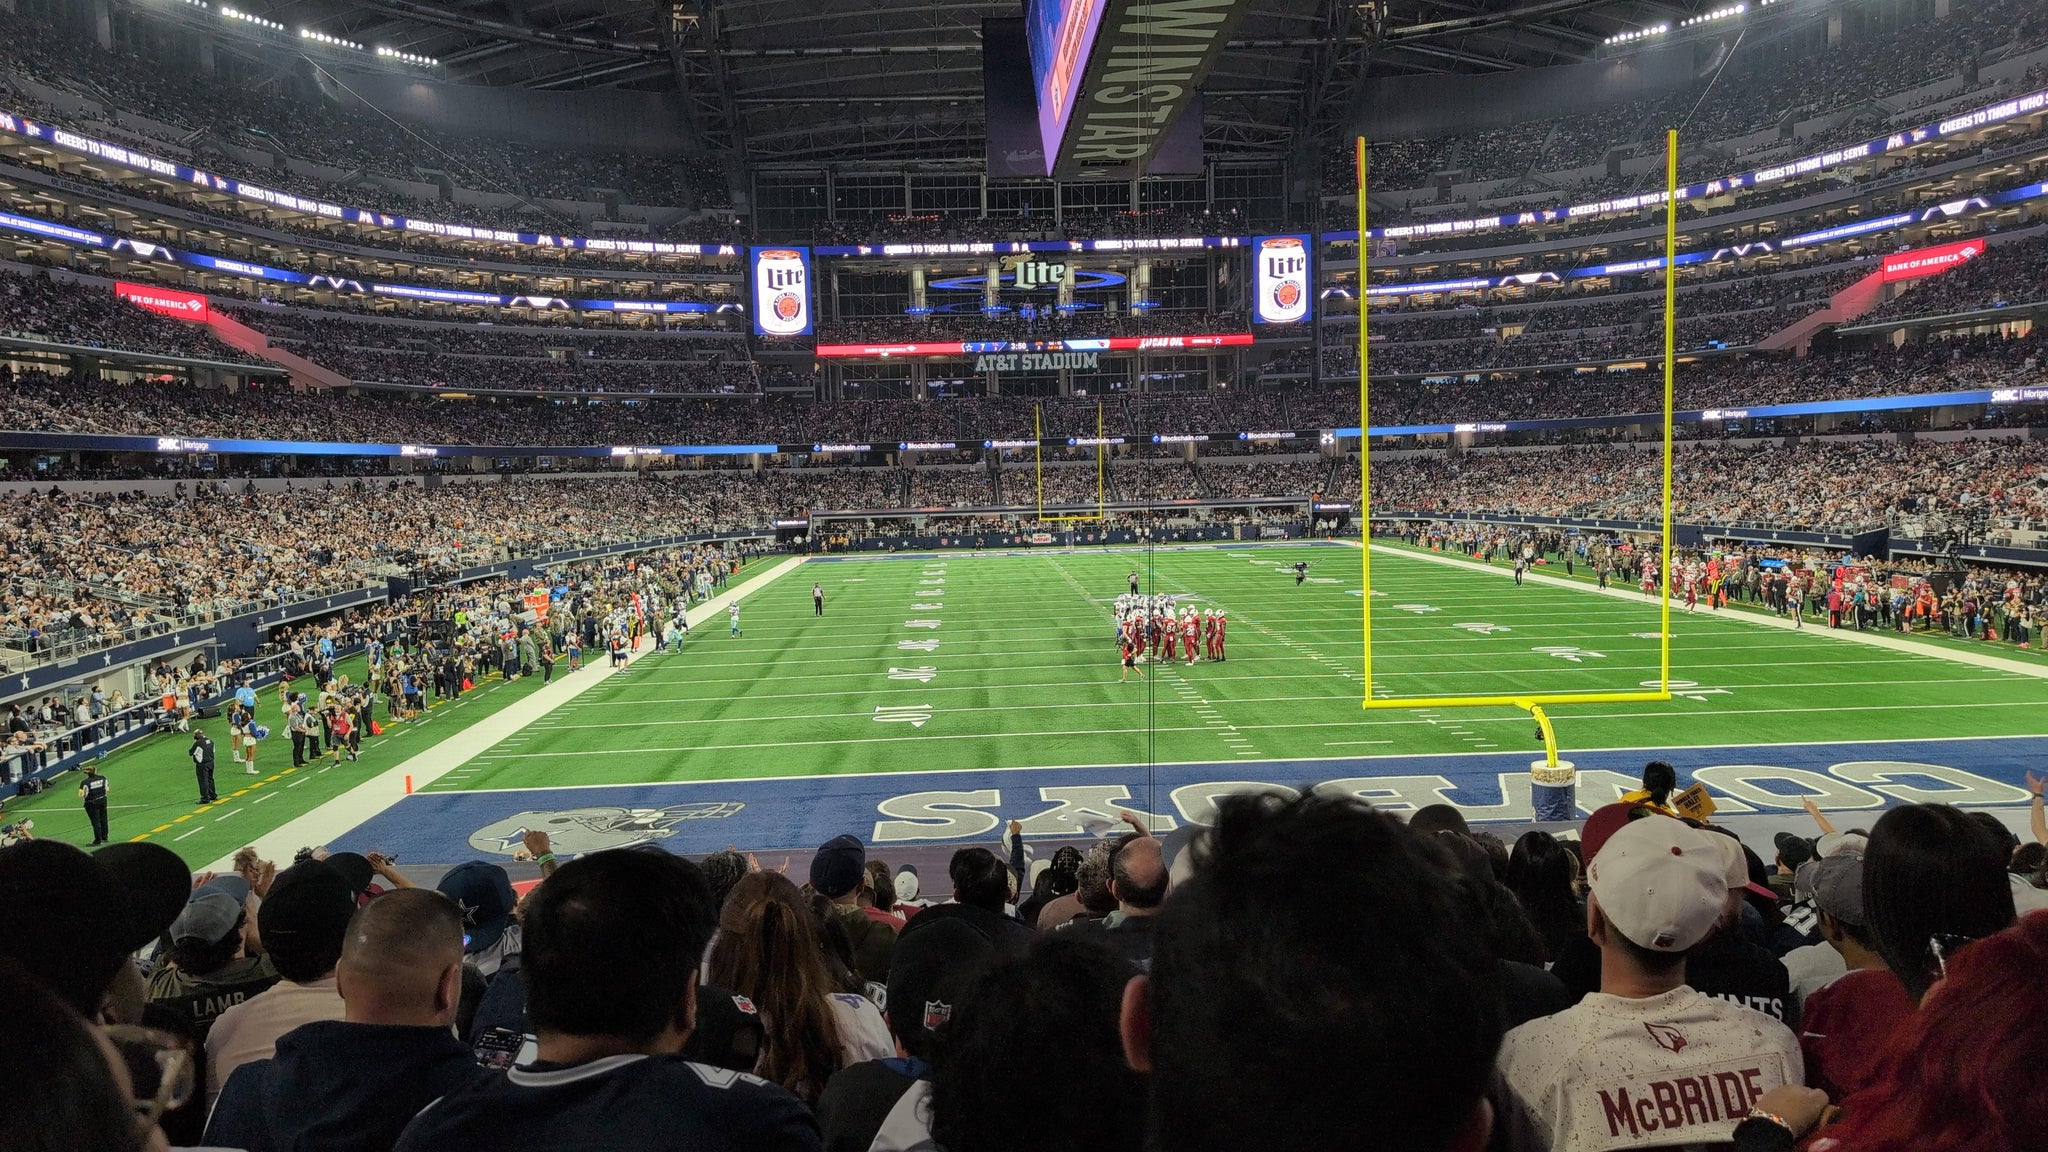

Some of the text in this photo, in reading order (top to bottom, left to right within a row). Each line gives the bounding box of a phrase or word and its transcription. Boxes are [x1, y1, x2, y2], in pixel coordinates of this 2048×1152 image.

[1073, 0, 1237, 159] WINSTAR
[1939, 95, 2044, 134] CHEERS TO THOSE WHO
[54, 130, 176, 176] CHEERS TO THOSE WHO SERVE
[1755, 145, 1868, 182] CHEERS TO THOSE WHO SERVE
[238, 183, 342, 217] CHEERS TO THOSE WHO SERVE
[1569, 188, 1687, 216] CHEERS TO THOSE WHO SEVE
[406, 219, 519, 242] CHEERS TO THOSE WHO SERVE
[1384, 217, 1500, 237] CHEERS TO THOSE WHO SERVE
[586, 239, 701, 253] CHEERS TO THOSE WHO SERVE
[884, 243, 993, 254] CHEERS TO THOSE WHO SERVE
[1094, 238, 1203, 249] CHEERS TO THOSE WHO SERVE
[1268, 256, 1305, 279] Lite
[1887, 253, 1958, 272] BANK OF AMERICA
[767, 268, 803, 291] Lite
[1013, 259, 1067, 291] Lite
[143, 296, 154, 305] OF
[155, 299, 188, 310] AMERICA
[1010, 342, 1027, 350] 3:50
[1139, 337, 1169, 349] LUCAS
[1169, 337, 1184, 346] OIL
[976, 352, 1098, 372] AT&T STADIUM
[1724, 410, 1748, 418] Mortgage
[1481, 423, 1507, 431] Mortgage
[1076, 437, 1124, 445] Blockchain.com
[1161, 434, 1209, 442] Blockchain.com
[1247, 431, 1296, 440] Blockchain.com
[184, 440, 208, 451] Mortgage
[821, 443, 871, 452] Blockchain.com
[907, 441, 956, 450] Blockchain.com
[992, 439, 1040, 448] Blockchain.com
[420, 447, 438, 455] Mortgage
[637, 447, 662, 455] Mortgage
[872, 703, 934, 722] 10
[193, 991, 246, 1018] LAMB
[1596, 1067, 1766, 1139] McBRIDE
